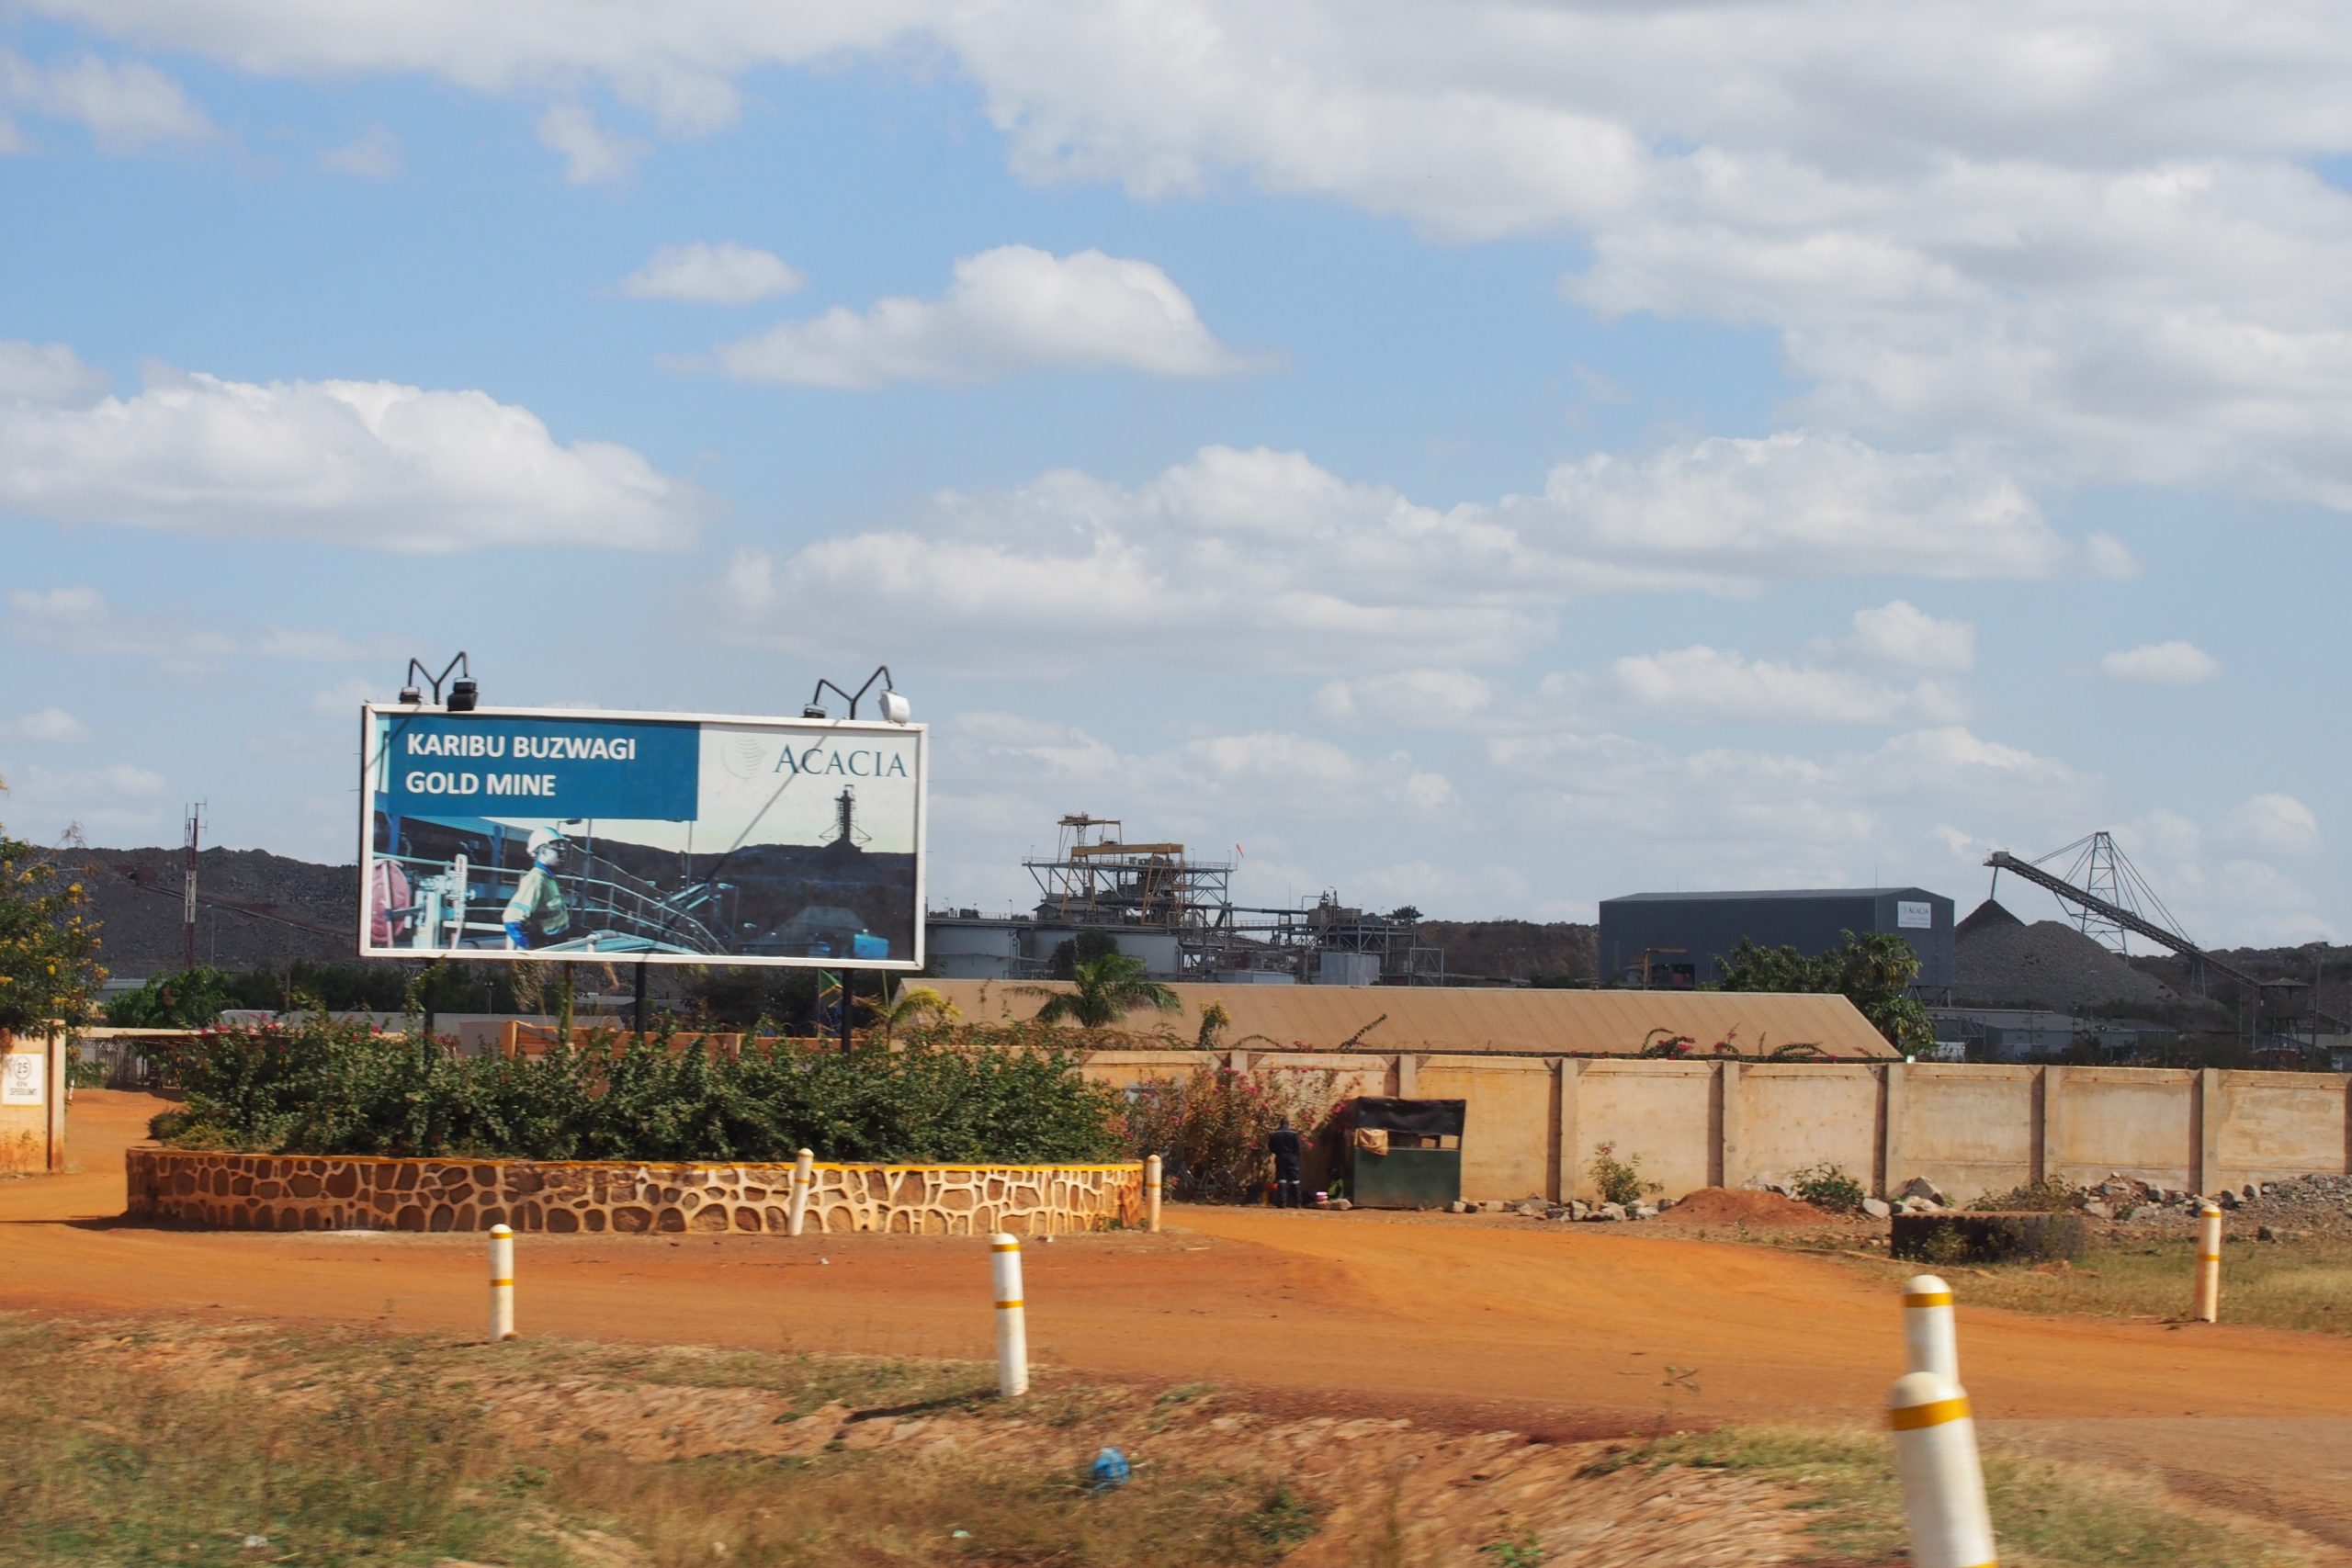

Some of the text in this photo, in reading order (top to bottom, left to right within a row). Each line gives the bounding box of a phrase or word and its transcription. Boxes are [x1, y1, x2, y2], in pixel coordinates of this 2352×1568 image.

[407, 733, 636, 761] KARIBU BUZWAGI
[773, 743, 909, 778] ACACIA
[405, 772, 557, 796] GOLD MINE
[17, 1062, 28, 1073] 25
